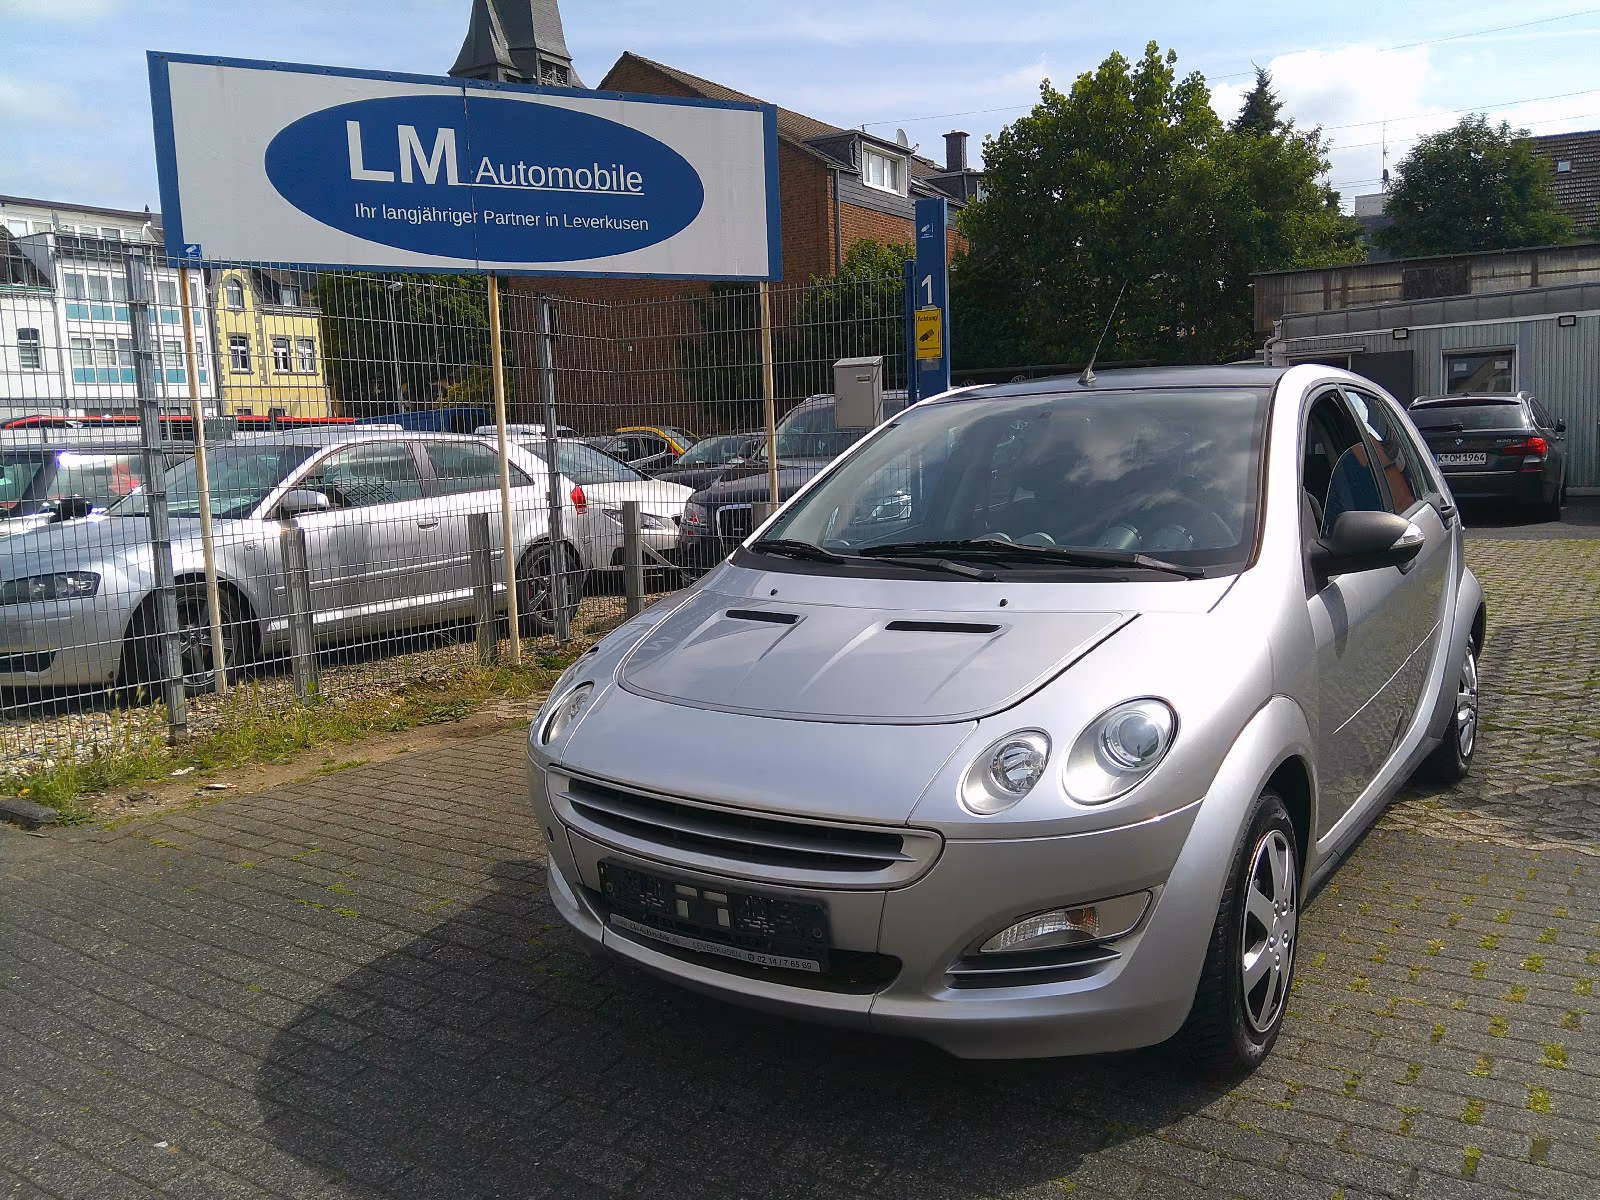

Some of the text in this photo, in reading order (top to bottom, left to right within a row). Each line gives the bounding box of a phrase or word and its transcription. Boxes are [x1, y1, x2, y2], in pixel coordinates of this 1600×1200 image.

[346, 120, 643, 192] LM Automobile
[354, 202, 649, 231] Ihr langjähriger Partner in Leverkusen
[921, 273, 933, 304] 1
[1463, 453, 1485, 462] 1964
